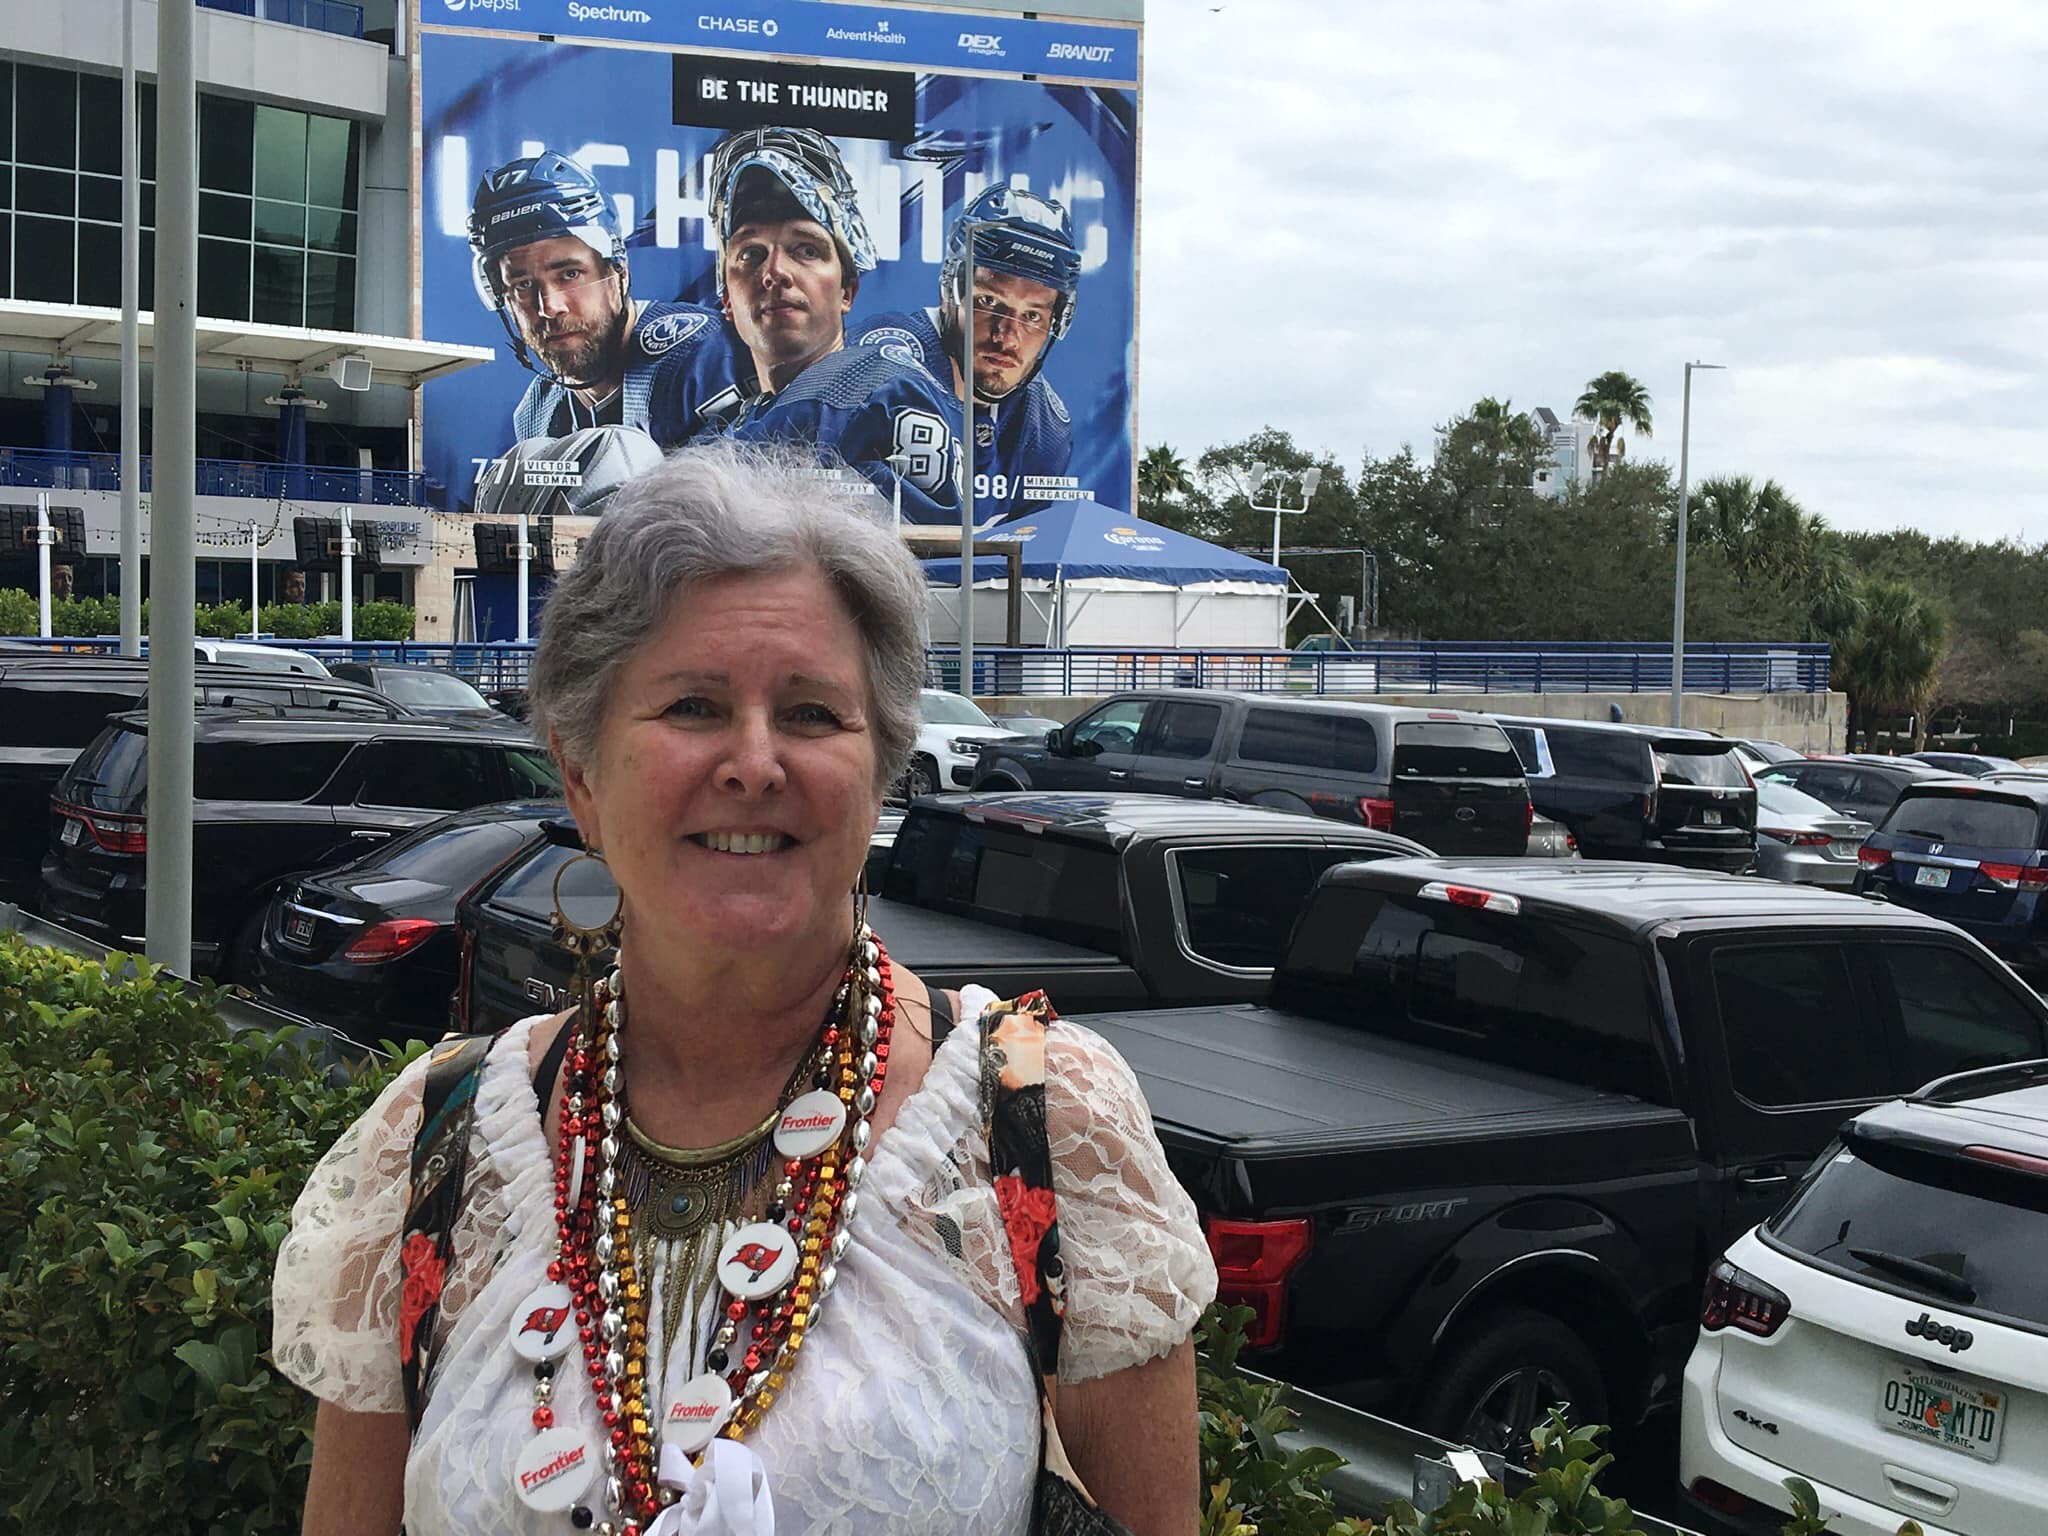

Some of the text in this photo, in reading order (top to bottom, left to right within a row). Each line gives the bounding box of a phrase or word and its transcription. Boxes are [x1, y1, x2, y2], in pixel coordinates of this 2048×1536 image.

[568, 2, 646, 23] Spectrum
[698, 15, 760, 34] CHASE
[826, 28, 907, 45] AdventHealth
[957, 33, 1003, 49] DEX
[1046, 43, 1115, 63] BRANDT
[701, 78, 889, 113] BE THE THUNDER
[496, 169, 528, 192] 77
[491, 202, 542, 225] BAUER
[526, 460, 573, 472] VICTOR
[526, 475, 578, 486] HEDMAN
[1025, 476, 1072, 487] MIKHAIL
[781, 1113, 838, 1129] Frontier
[1332, 1197, 1469, 1237] SPORT
[1904, 1312, 1974, 1354] Jeep
[669, 1401, 720, 1419] Frontier
[519, 1444, 587, 1489] Frontier
